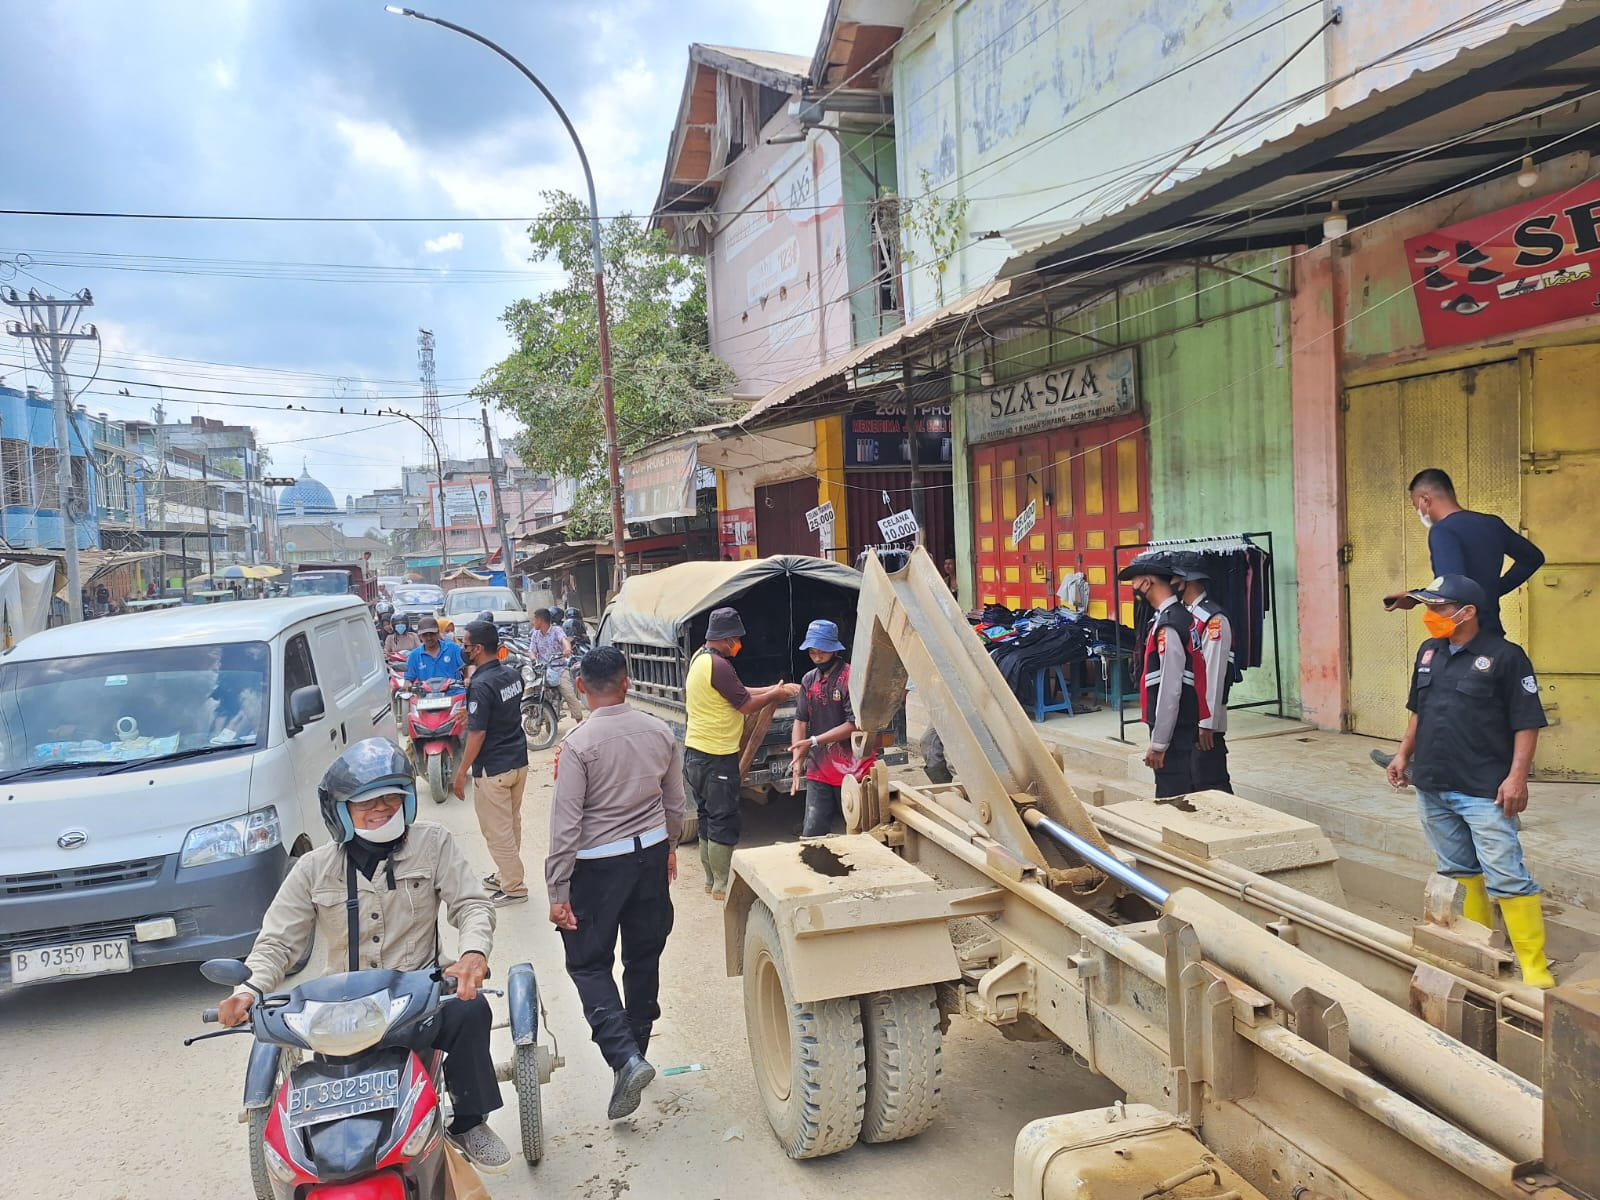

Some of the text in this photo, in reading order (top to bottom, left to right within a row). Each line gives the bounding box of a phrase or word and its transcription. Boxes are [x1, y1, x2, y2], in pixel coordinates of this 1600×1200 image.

[990, 363, 1100, 419] SZA-SZA
[809, 510, 834, 530] 25.000
[882, 513, 910, 528] CELANA
[884, 520, 917, 541] 10.000
[17, 942, 124, 972] B 9359 PCX
